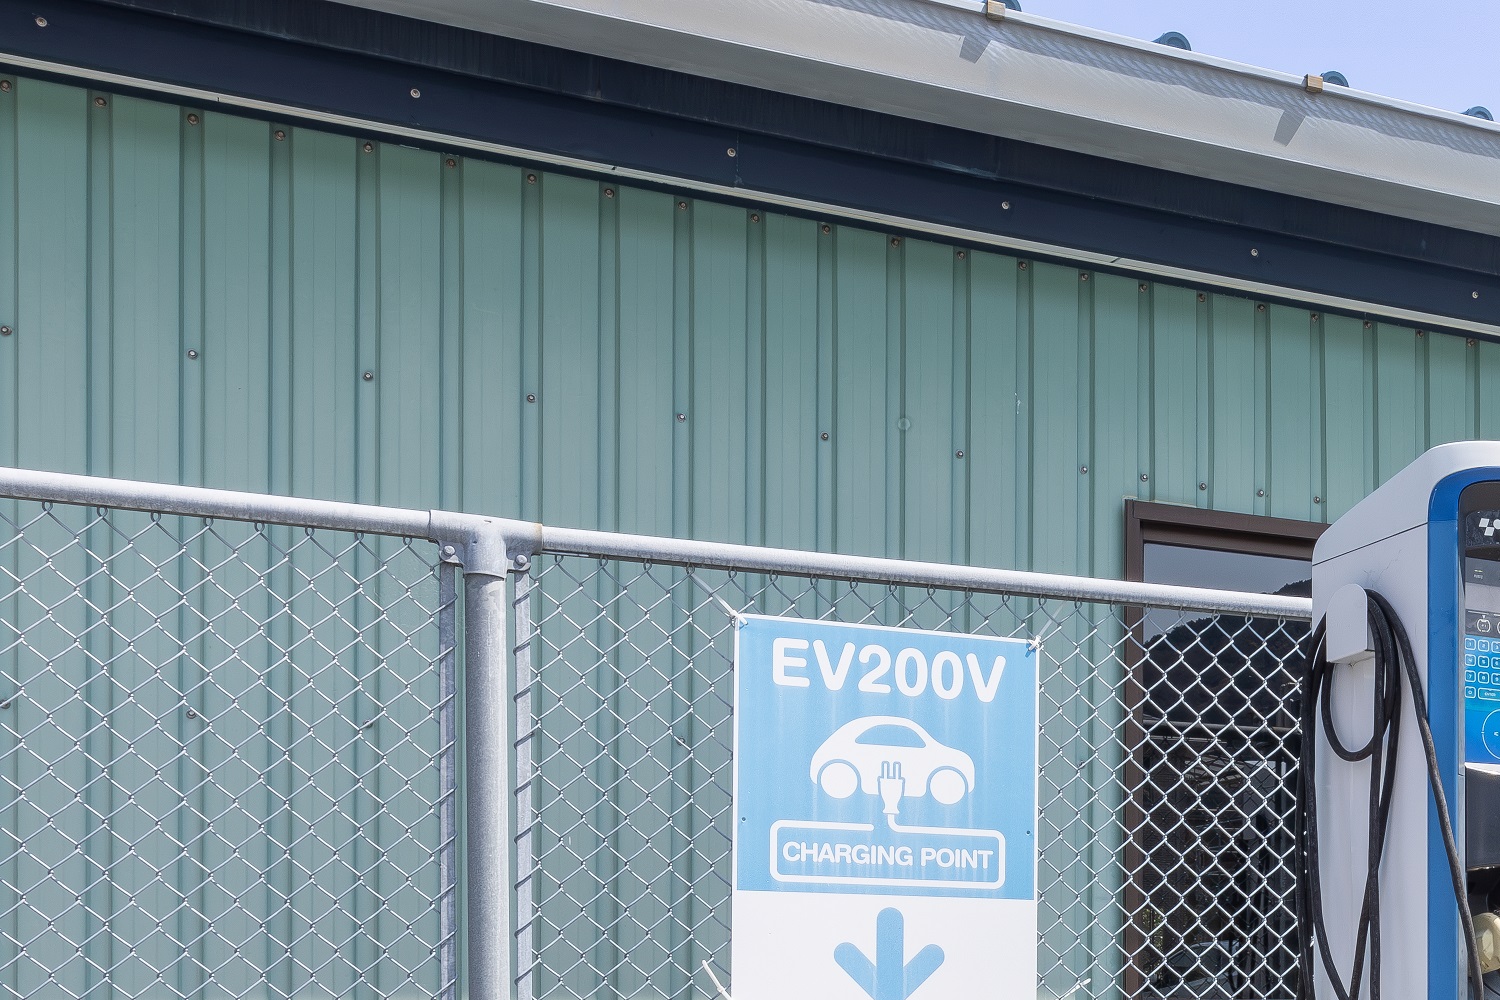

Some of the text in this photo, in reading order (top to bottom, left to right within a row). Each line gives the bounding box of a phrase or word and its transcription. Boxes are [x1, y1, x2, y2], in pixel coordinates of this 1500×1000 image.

[772, 637, 1007, 703] EV200V
[782, 841, 994, 869] CHARGING POINT
